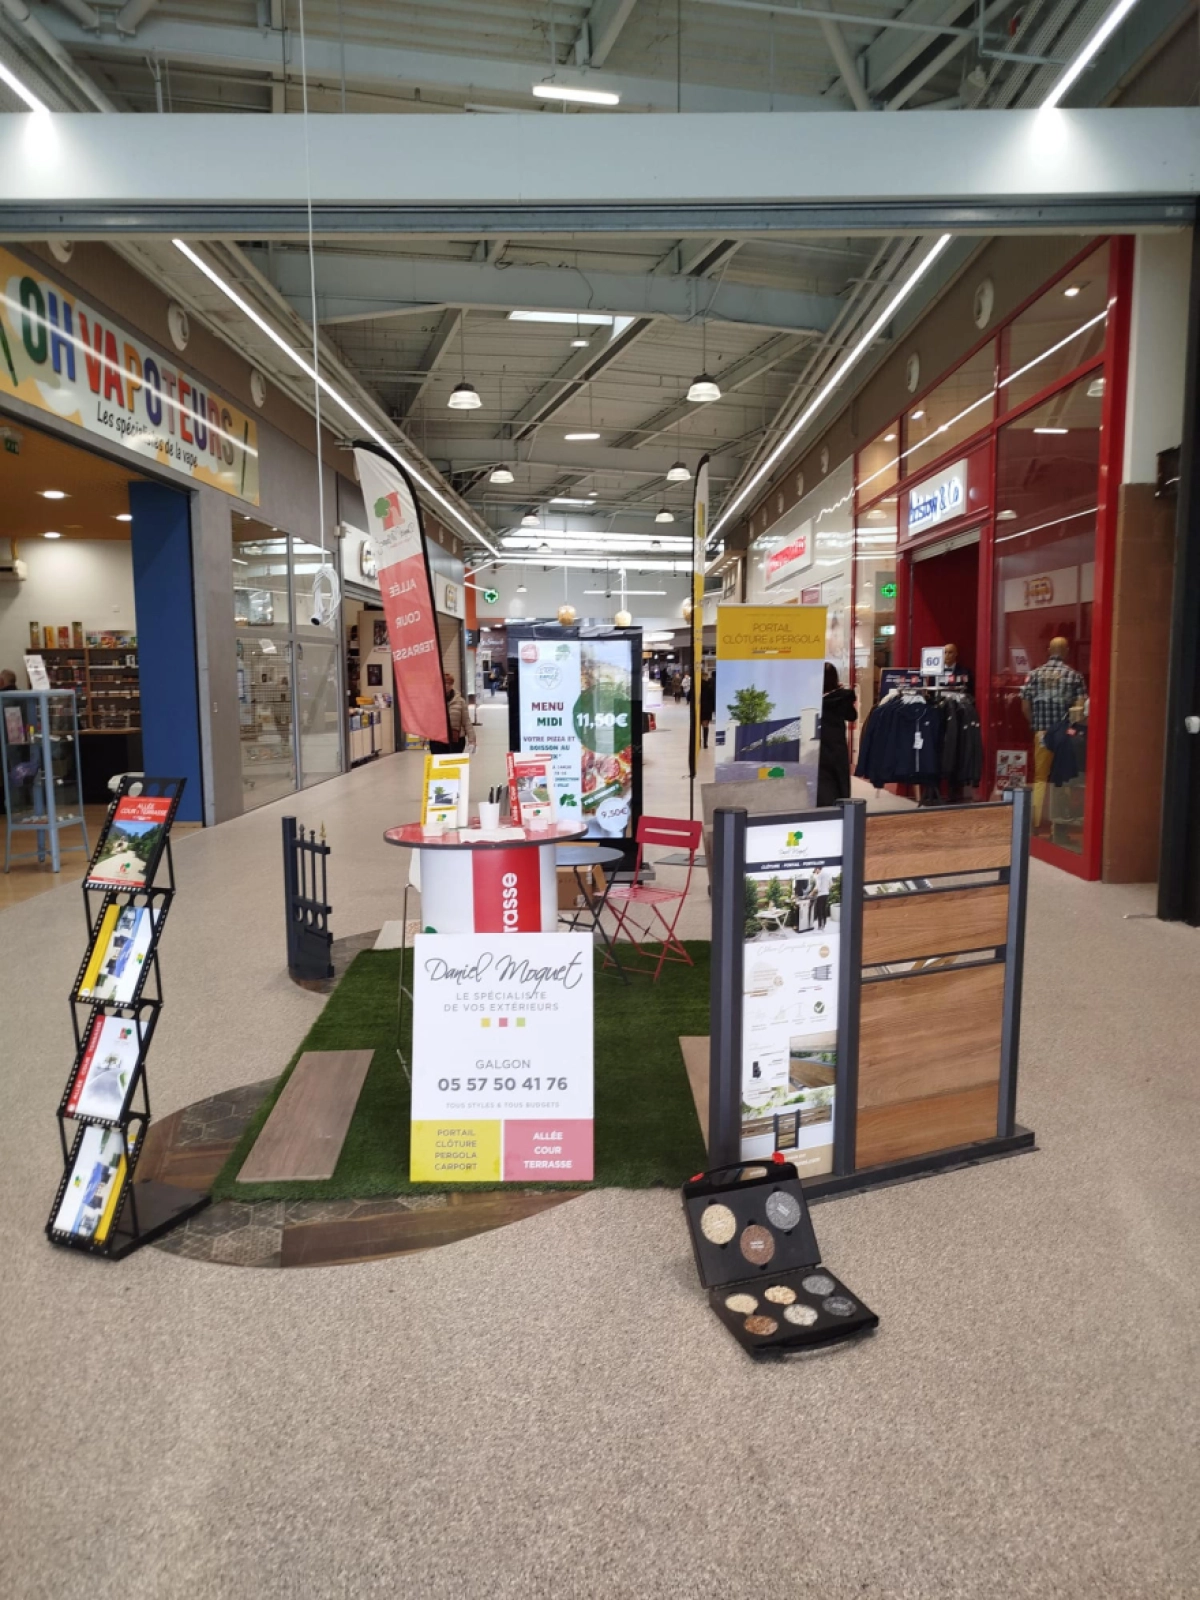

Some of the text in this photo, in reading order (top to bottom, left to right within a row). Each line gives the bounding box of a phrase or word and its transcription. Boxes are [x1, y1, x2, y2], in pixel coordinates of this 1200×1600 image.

[97, 401, 113, 428] Les
[165, 439, 174, 457] de
[176, 442, 181, 460] la
[183, 450, 198, 470] vape
[752, 623, 792, 633] PORTAIL
[722, 633, 767, 645] CLÔTURE
[776, 634, 821, 645] PERGOLA
[926, 657, 940, 667] 60
[531, 702, 564, 712] MENU
[537, 717, 563, 727] MIDI
[576, 713, 628, 729] 11,50€
[601, 807, 628, 819] 9,50€
[502, 872, 519, 933] rasse
[424, 950, 583, 999] Daniel Moquet
[456, 990, 547, 1000] LE SPÉCIALISTE
[444, 1002, 559, 1012] DE VOS EXTÉRIEURS
[475, 1059, 531, 1070] GALGON
[438, 1077, 568, 1092] 05 57 50 41 76
[437, 1129, 476, 1137] PORTAIL
[532, 1130, 563, 1140] ALLÉE
[435, 1140, 477, 1148] CLÔTURE
[533, 1146, 562, 1155] COUR
[434, 1163, 478, 1171] CARPORT
[523, 1160, 572, 1169] TERRASSE
